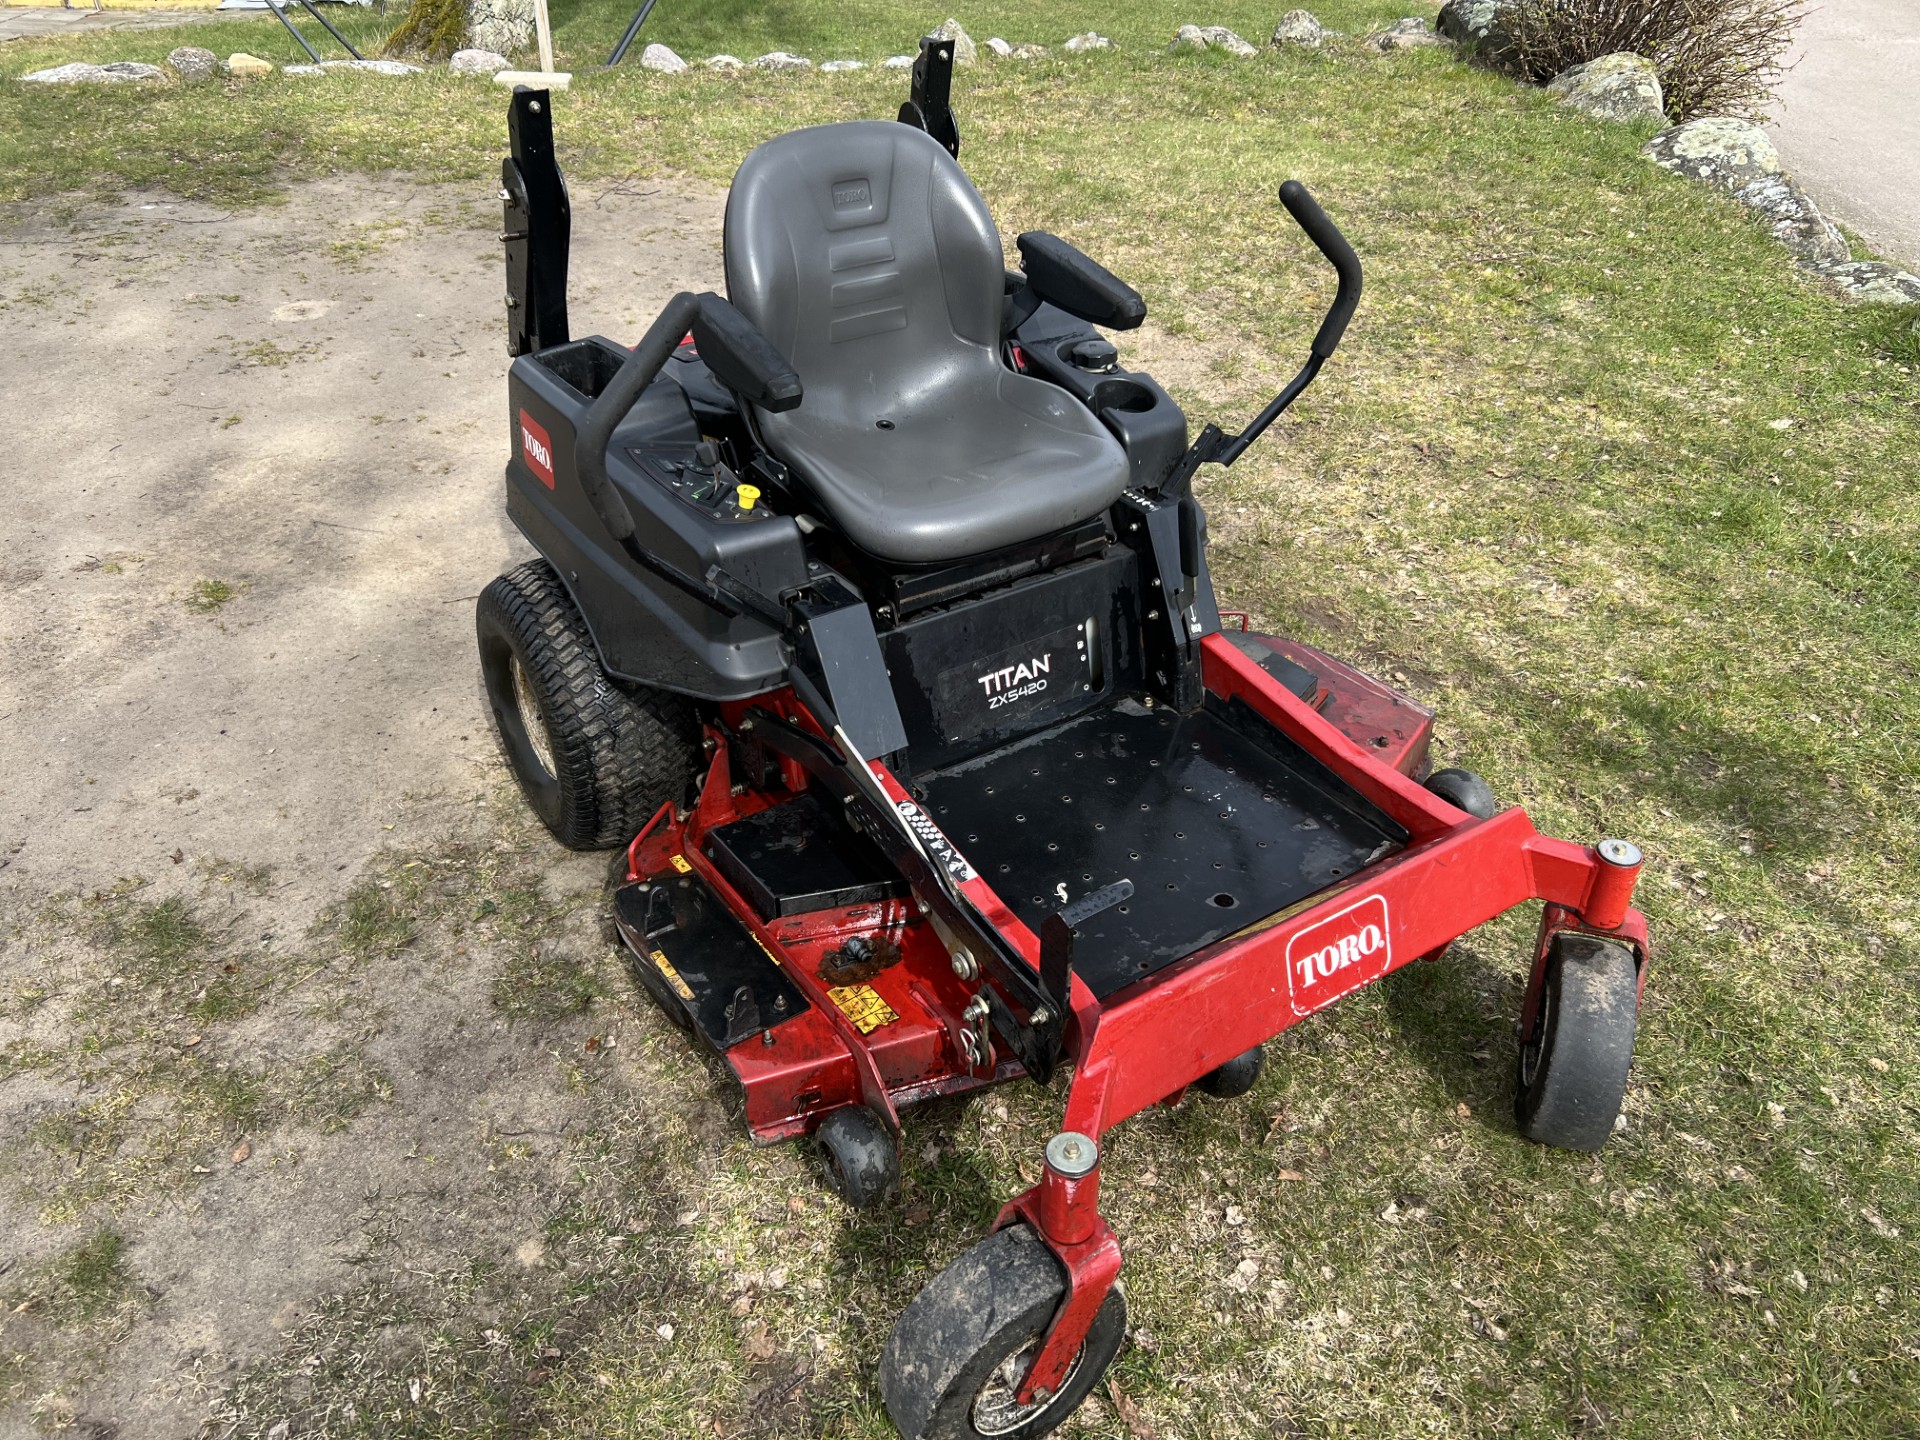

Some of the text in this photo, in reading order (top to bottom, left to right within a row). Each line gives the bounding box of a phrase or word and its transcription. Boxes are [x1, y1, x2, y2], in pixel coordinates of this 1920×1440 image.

[522, 426, 551, 471] TORO
[978, 654, 1050, 696] TITAN
[987, 679, 1048, 710] ZX5420
[1296, 924, 1382, 988] TORO
